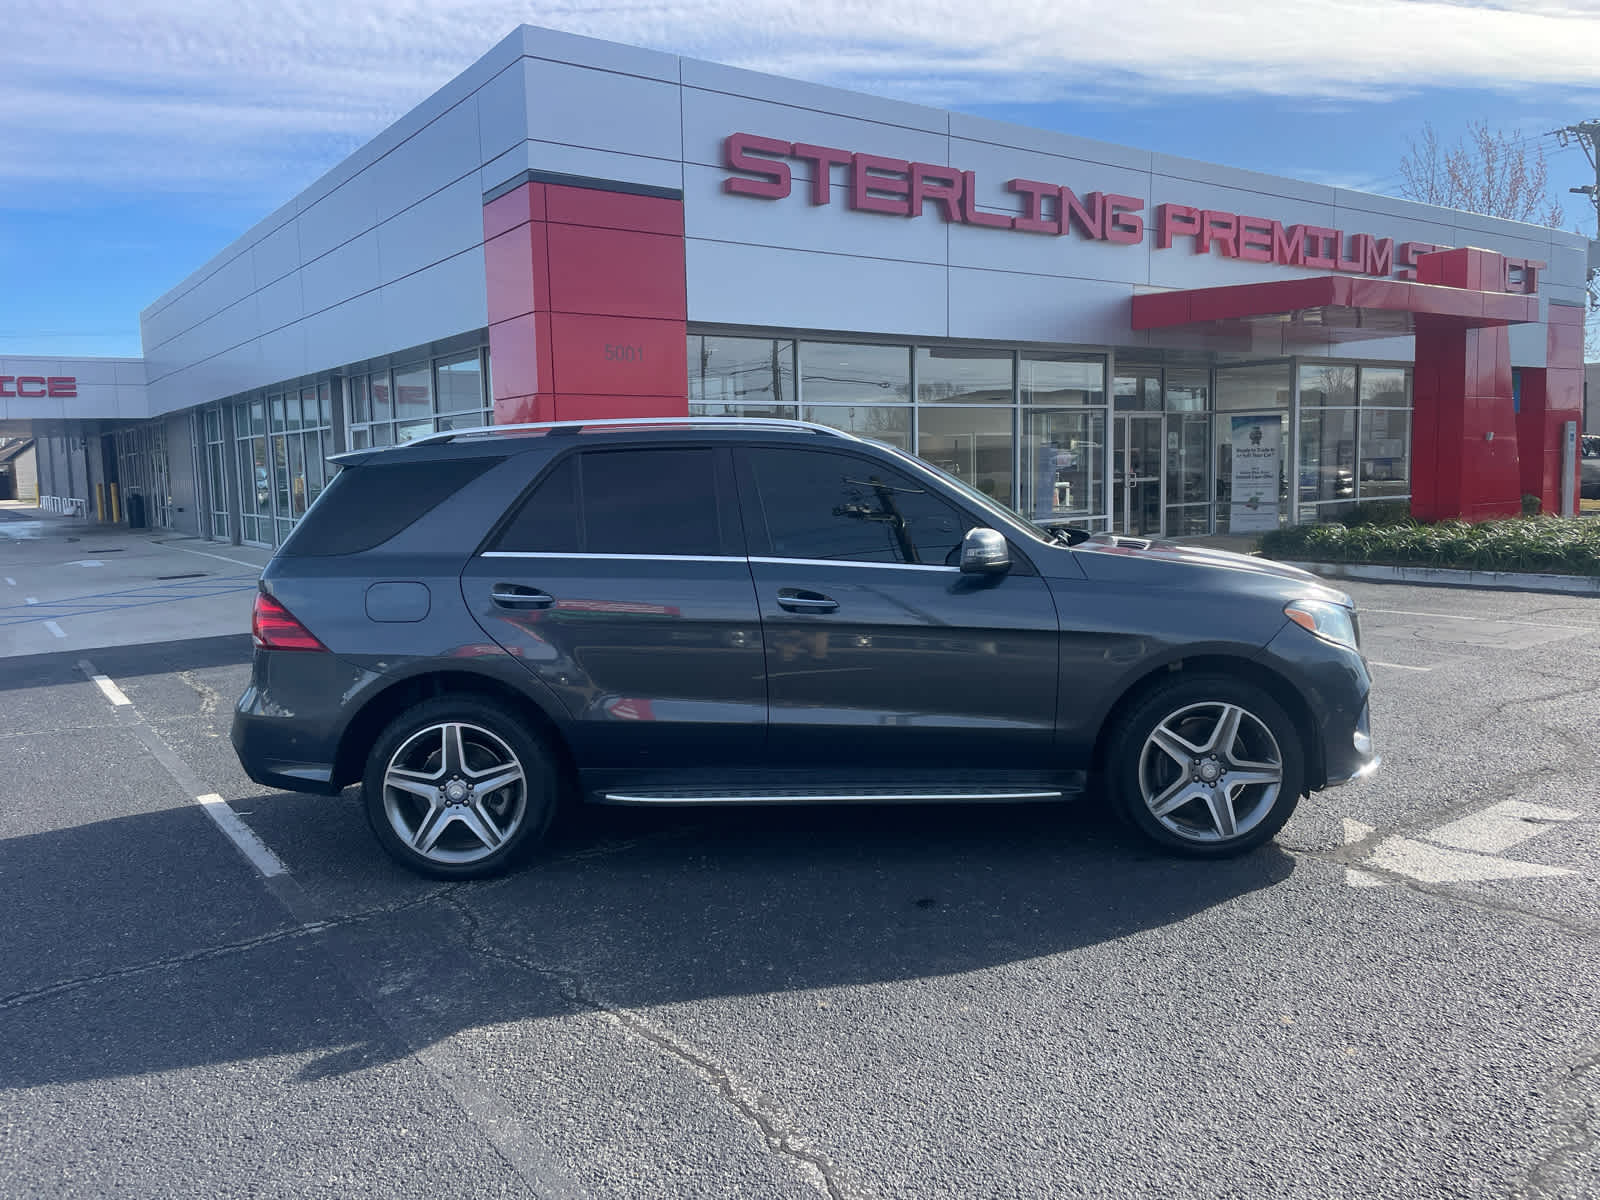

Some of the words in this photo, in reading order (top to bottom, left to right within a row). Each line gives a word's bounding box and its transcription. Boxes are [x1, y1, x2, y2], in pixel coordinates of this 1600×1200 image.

[722, 132, 1144, 245] STERLING
[1157, 202, 1393, 276] PREMIUM
[1400, 241, 1547, 293] SCT
[604, 343, 644, 363] 5001
